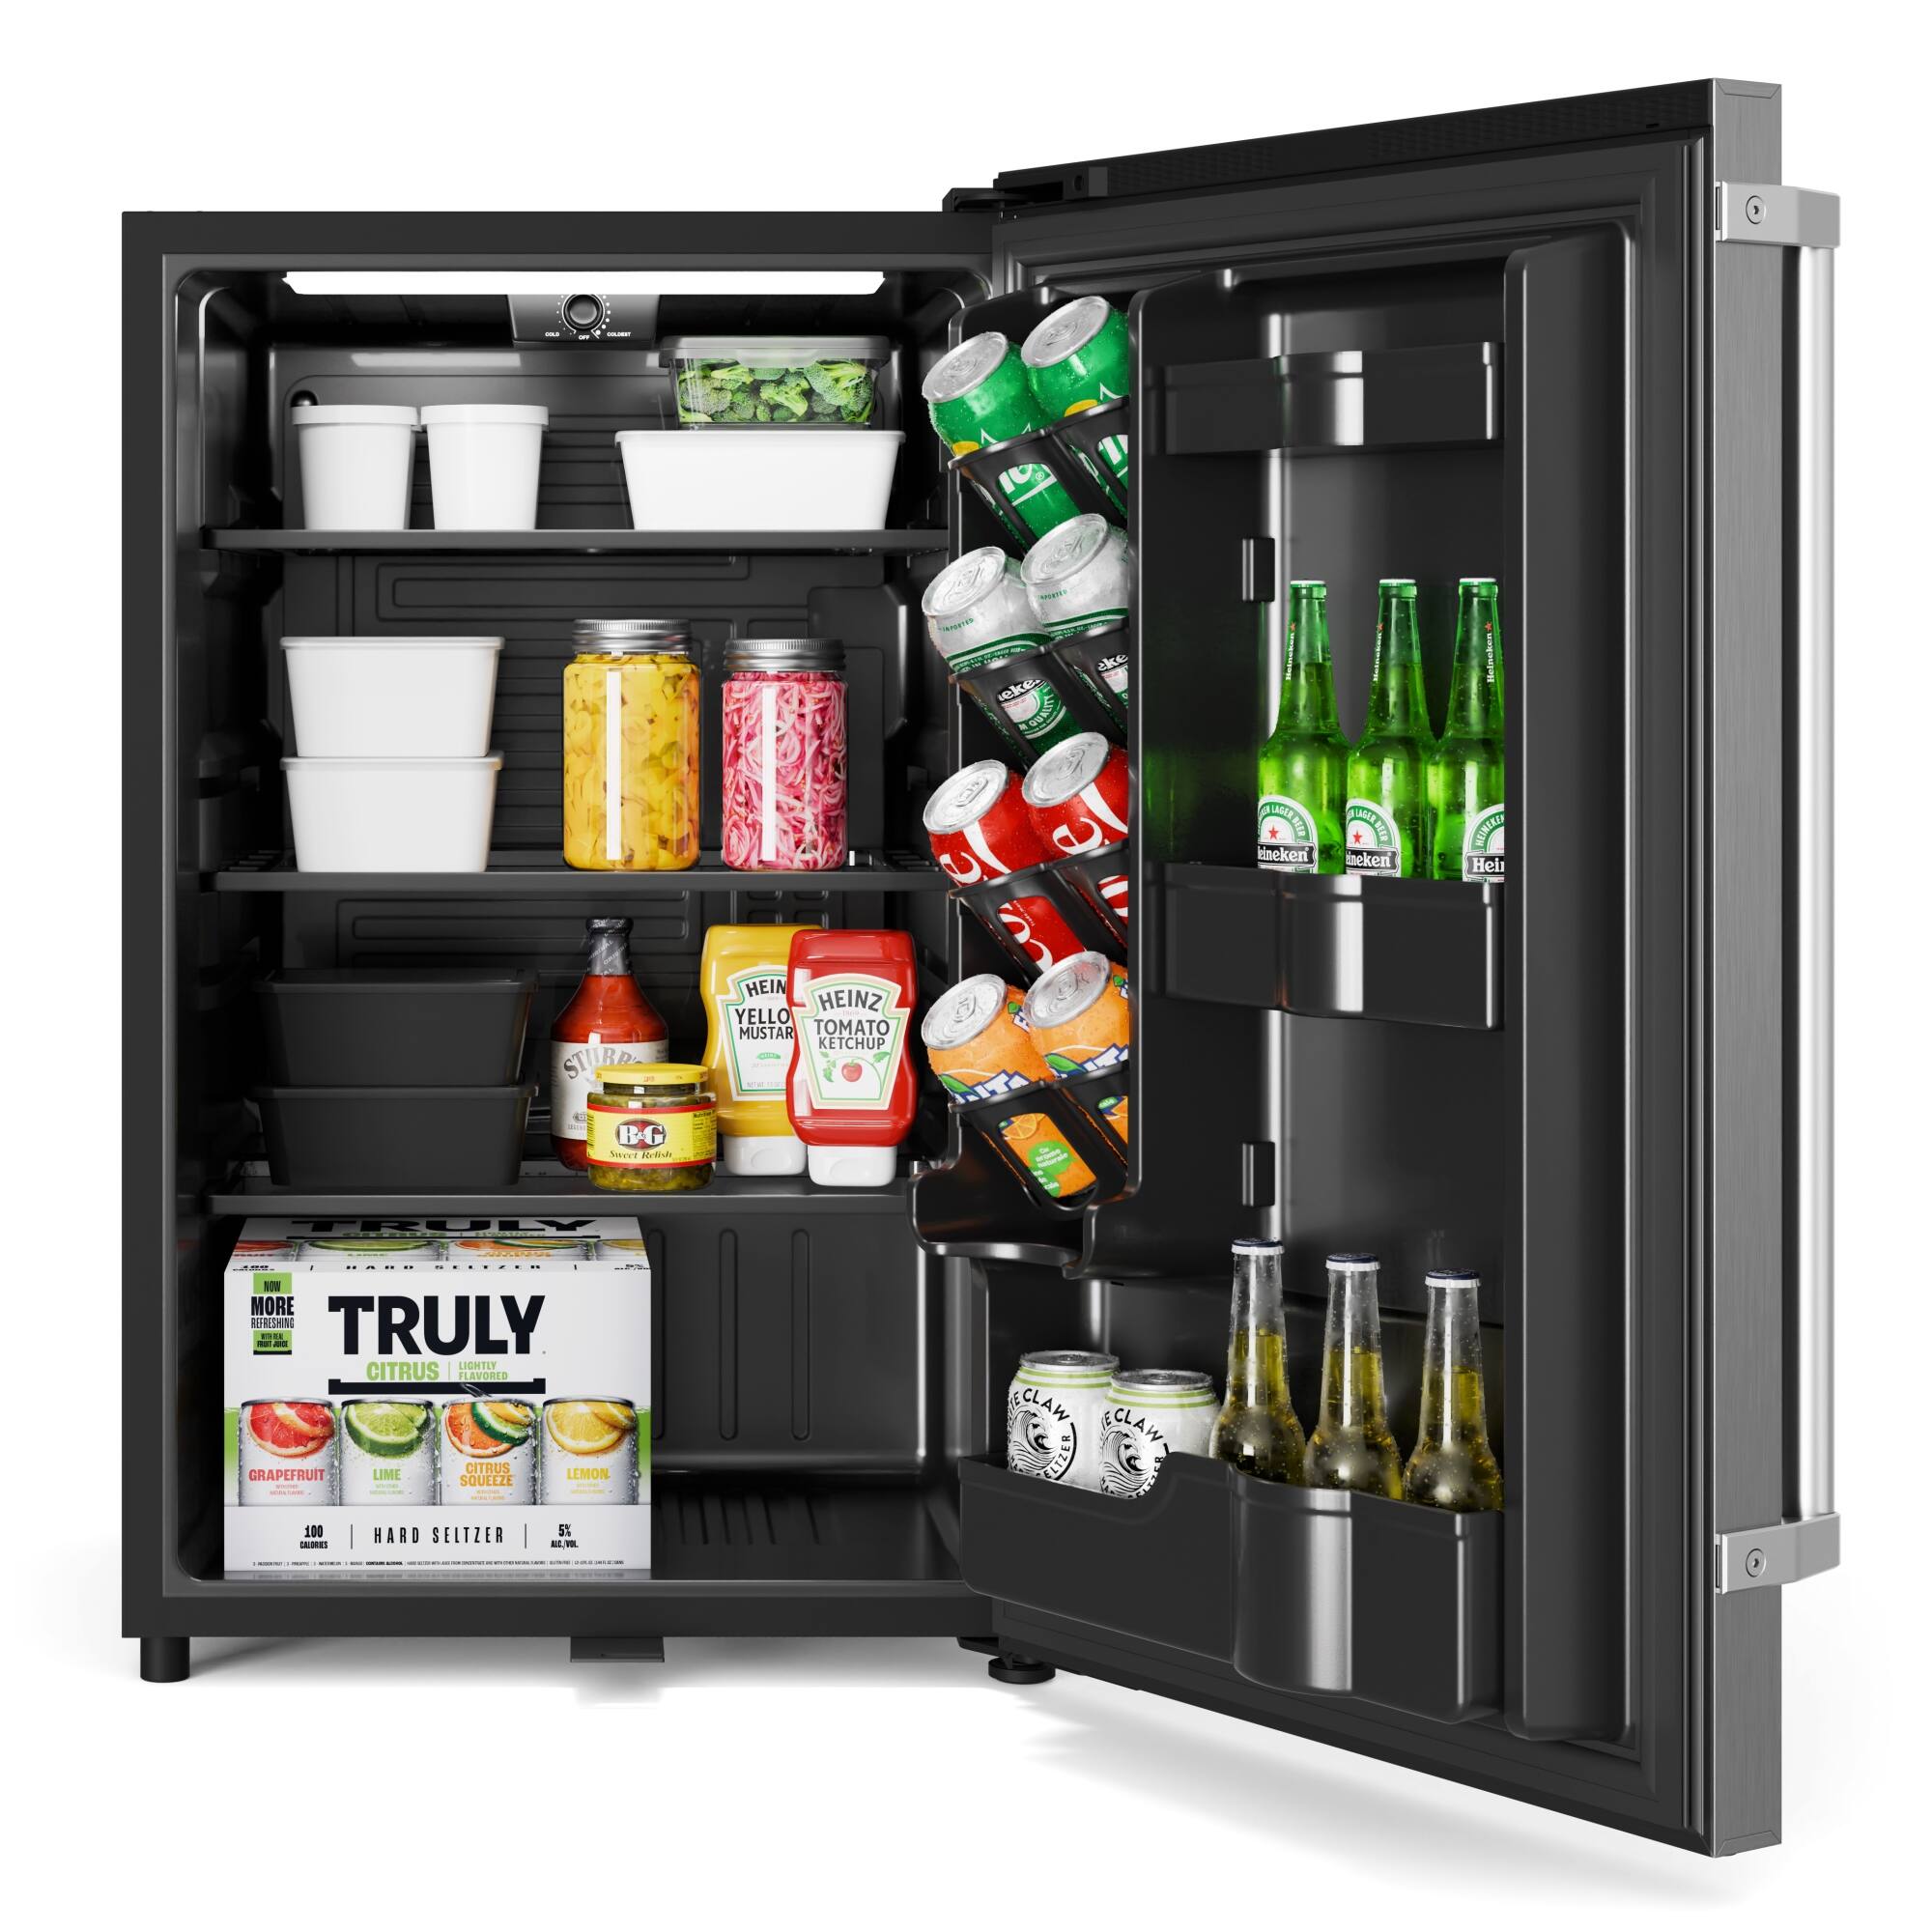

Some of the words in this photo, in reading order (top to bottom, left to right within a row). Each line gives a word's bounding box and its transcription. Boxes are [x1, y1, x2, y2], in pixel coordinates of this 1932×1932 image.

[943, 617, 974, 632] IMPORTED
[1097, 654, 1128, 671] eke
[1285, 633, 1295, 681] Heineken
[1373, 633, 1382, 682] Heineken
[1029, 694, 1055, 727] QUALITY
[1271, 804, 1293, 820] LAGER
[1293, 816, 1306, 838] BEER
[1355, 808, 1377, 825] LAGER
[1374, 820, 1389, 841] BEER
[1346, 851, 1391, 867] eineken
[1472, 857, 1504, 873] Hei
[745, 979, 787, 998] HEIN
[817, 989, 883, 1012] HEINZ
[735, 1008, 790, 1025] YELLO
[739, 1026, 794, 1040] MUSTAR
[813, 1019, 891, 1037] TOMATO
[818, 1037, 886, 1050] KETCHUP
[609, 1150, 639, 1160] Sweet
[641, 1150, 672, 1160] Relish
[292, 1219, 596, 1233] TRULY
[264, 1280, 281, 1293] NOW
[251, 1295, 295, 1316] MORE
[251, 1317, 295, 1329] REFRESHING
[328, 1294, 546, 1355] TRULY
[366, 1361, 440, 1381] CITRUS
[458, 1361, 497, 1371] LIGHTLY
[458, 1371, 508, 1380] FLAVORED
[1023, 1388, 1070, 1422] CLAW
[1114, 1407, 1164, 1442] CLAW
[248, 1468, 326, 1482] GRAPEFRUIT
[373, 1468, 402, 1481] LIME
[466, 1462, 511, 1475] CITRUS
[566, 1467, 611, 1481] LEMON
[460, 1474, 514, 1487] SQUEEZE
[304, 1524, 324, 1539] 100
[374, 1526, 420, 1544] HARD
[433, 1526, 503, 1544] SELTZER
[558, 1523, 572, 1537] 5%
[299, 1541, 328, 1549] CALORIES
[551, 1539, 579, 1549] ALC./VOL.
